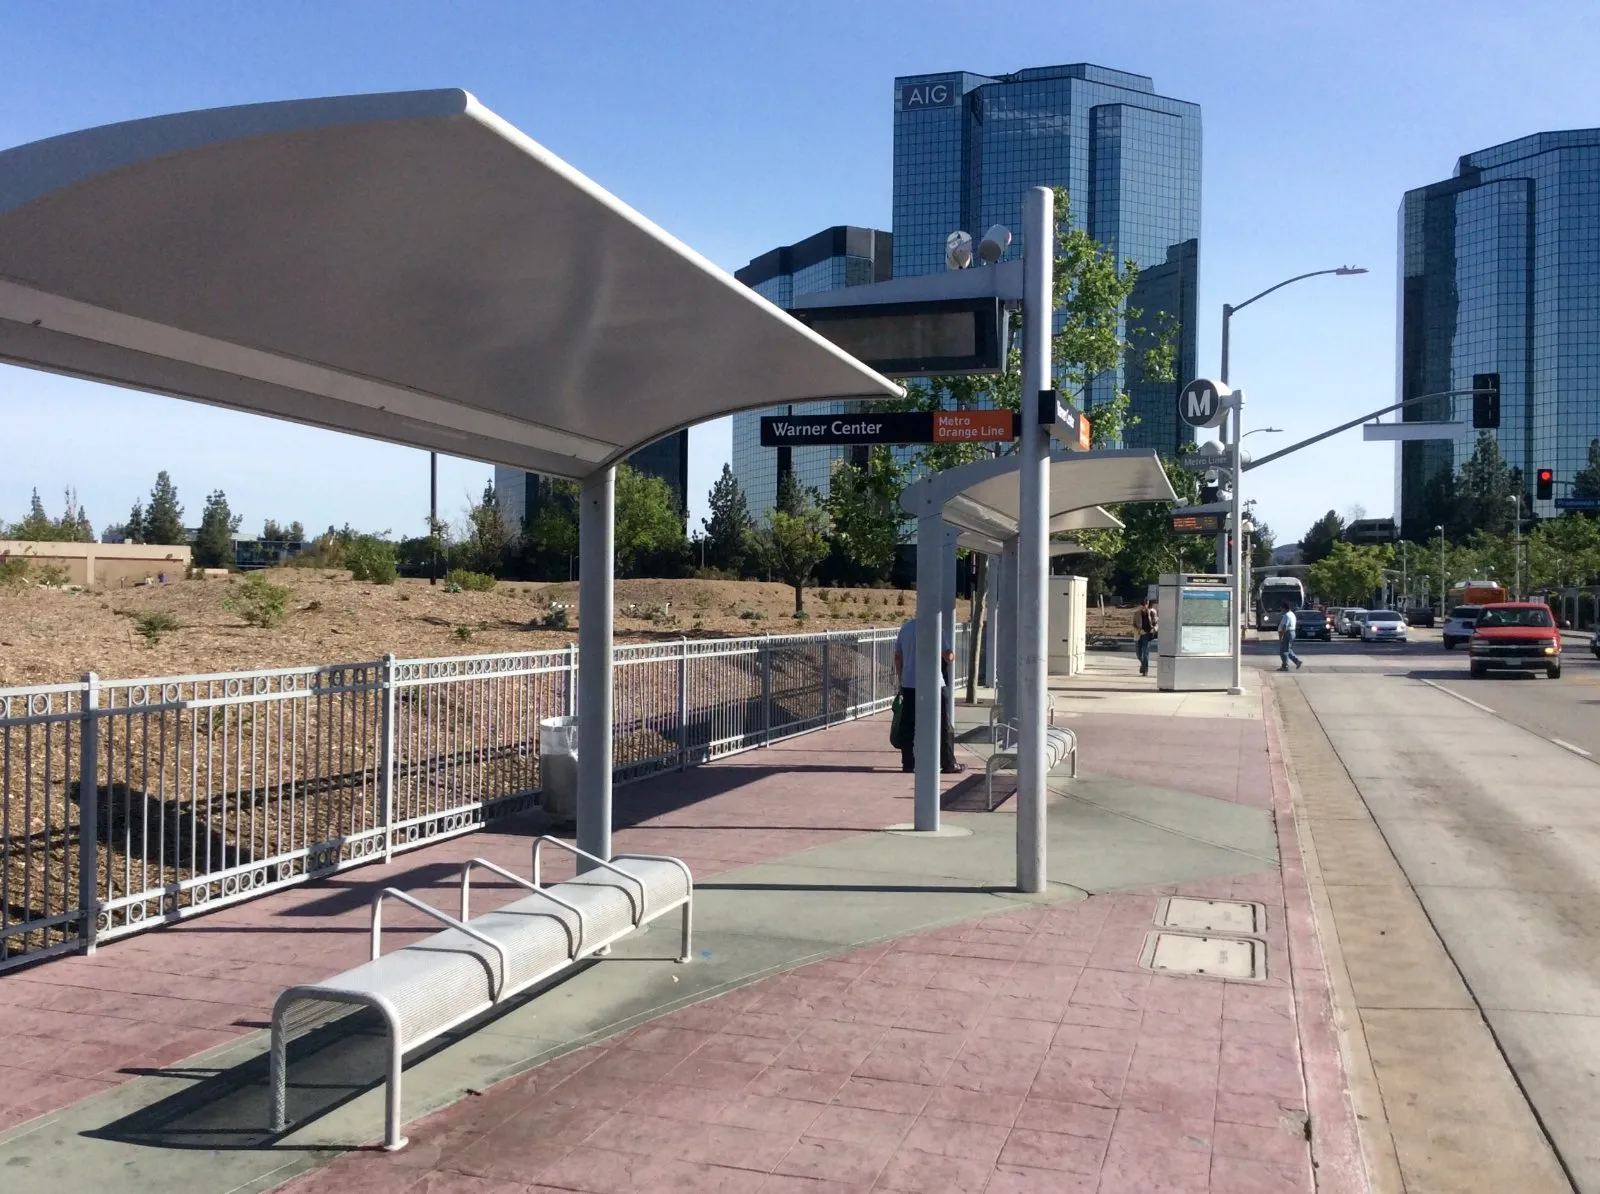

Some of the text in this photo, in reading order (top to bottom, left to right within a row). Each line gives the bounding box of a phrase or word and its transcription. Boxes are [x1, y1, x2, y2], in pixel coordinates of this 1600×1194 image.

[908, 85, 947, 106] AIG
[1187, 389, 1211, 417] M
[939, 416, 971, 425] Metro
[772, 421, 882, 436] Warner Center
[938, 426, 1004, 438] Orange Line
[1184, 458, 1207, 466] Metro
